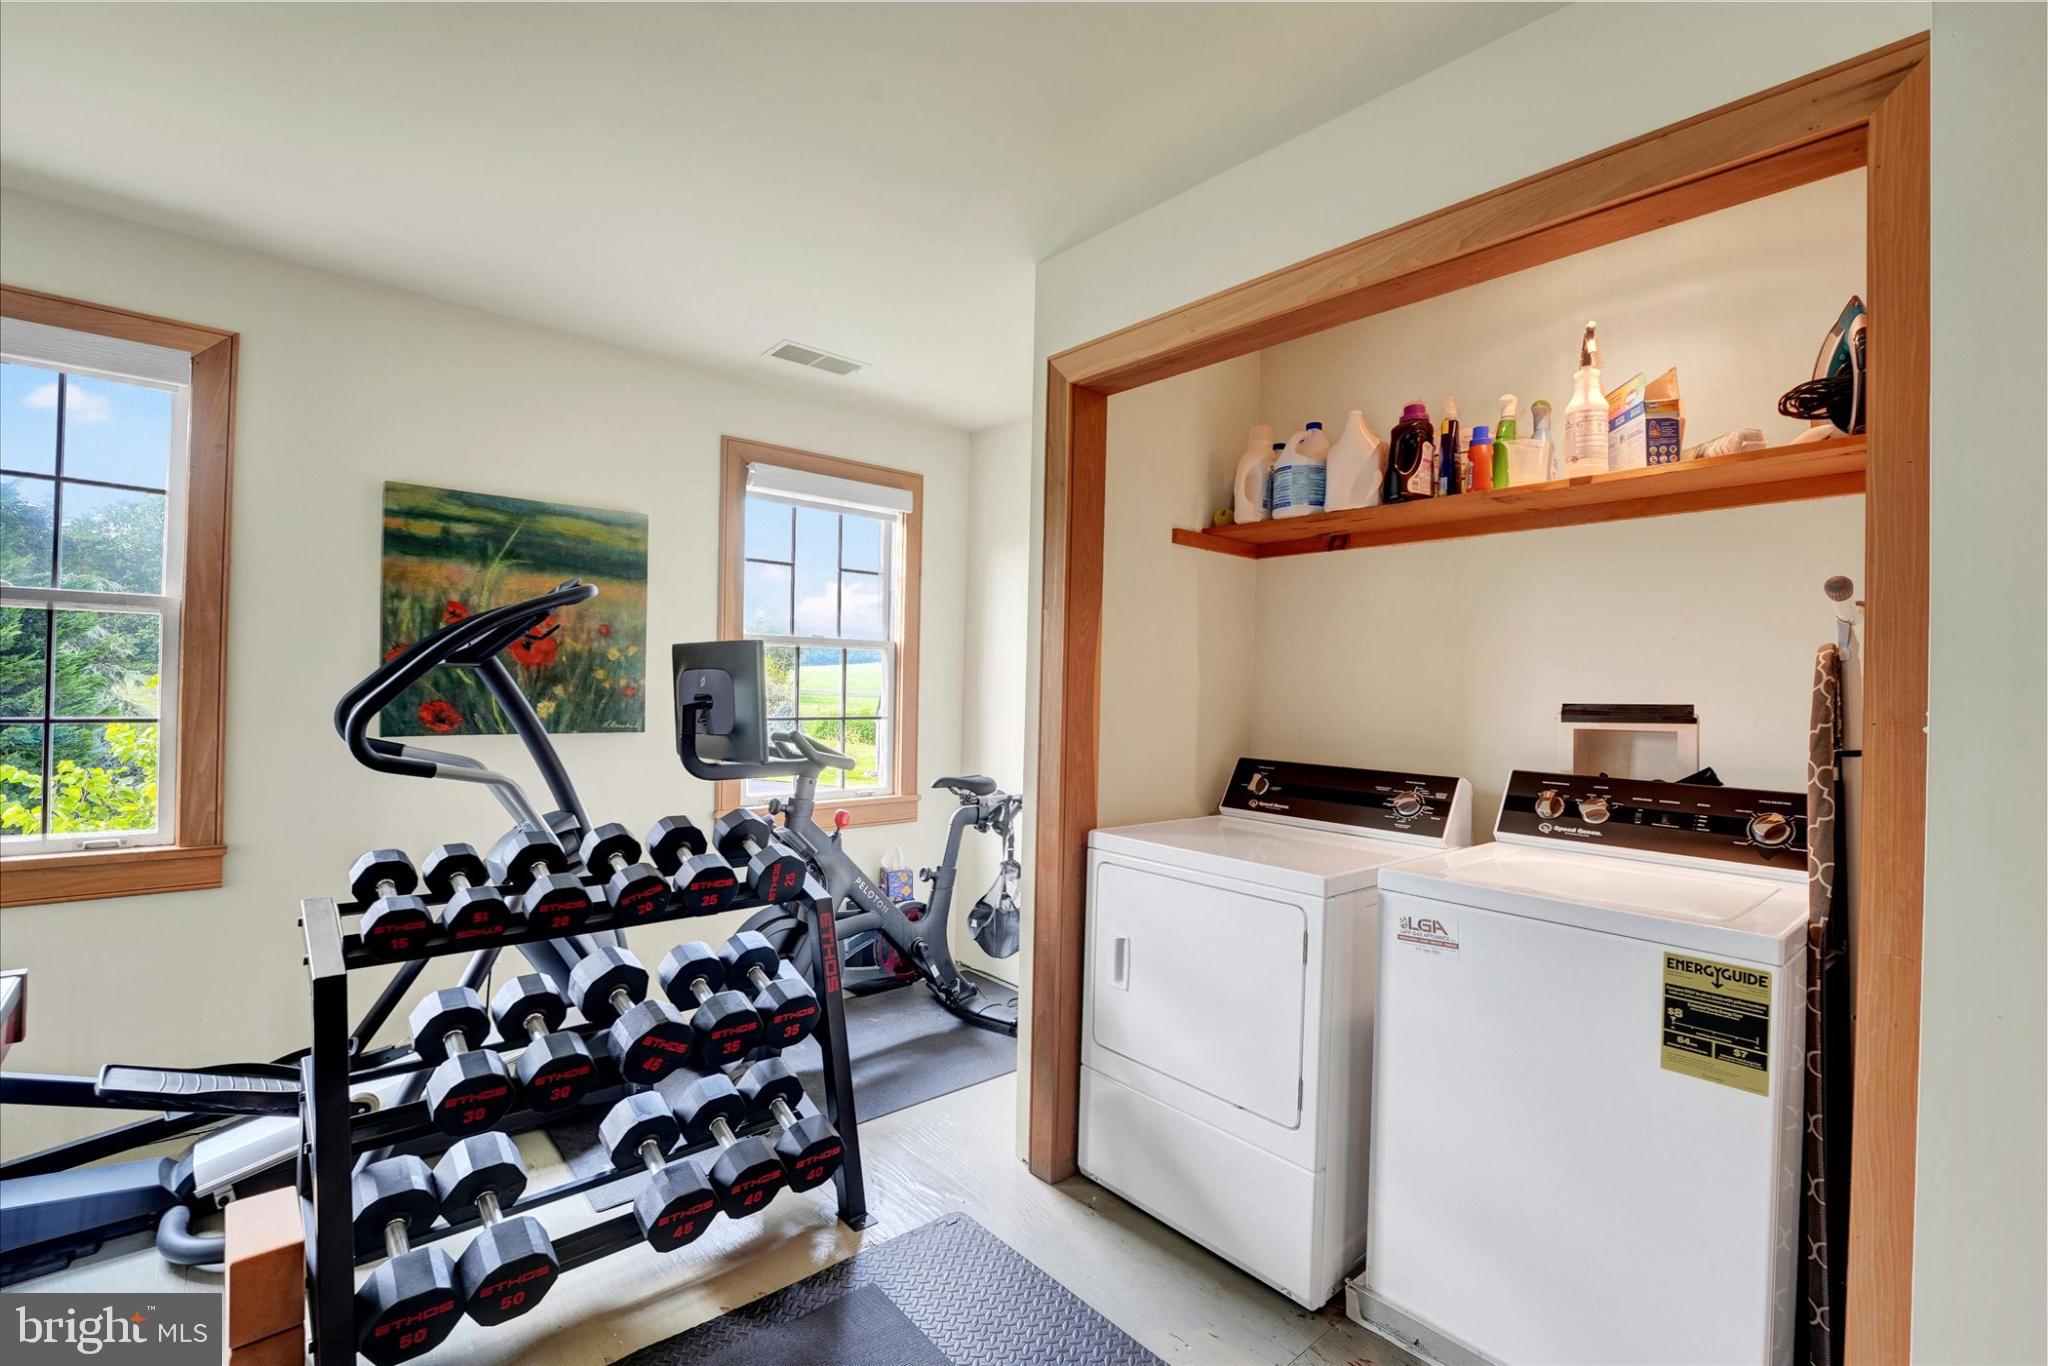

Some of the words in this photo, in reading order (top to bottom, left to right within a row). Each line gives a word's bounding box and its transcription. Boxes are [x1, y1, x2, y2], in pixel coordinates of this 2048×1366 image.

[1553, 824, 1576, 834] Speed
[690, 878, 734, 891] ETHOS
[768, 863, 782, 901] ETHOS
[784, 872, 796, 887] 25
[621, 884, 664, 906] ETHOS
[701, 894, 718, 906] 25
[855, 877, 889, 913] PELOTON
[637, 902, 653, 915] 20
[552, 916, 570, 928] 20
[1408, 916, 1449, 936] LGA
[391, 938, 408, 950] 15
[820, 912, 839, 993] ETHOS
[1666, 957, 1769, 988] ENERGYGUIDE
[774, 1006, 816, 1024] ETHOS
[1667, 1007, 1684, 1018] $8
[711, 1021, 758, 1040] ETHOS
[783, 1023, 800, 1038] 35
[642, 1036, 688, 1054] ETHOS
[722, 1040, 741, 1055] 35
[642, 1056, 664, 1071] 45
[534, 1065, 591, 1087] ETHOS
[550, 1086, 571, 1100] 30
[463, 1107, 485, 1124] 30
[796, 1146, 841, 1169] ETHOS
[730, 1169, 782, 1195] ETHOS
[805, 1166, 825, 1180] 40
[744, 1190, 763, 1206] 40
[658, 1199, 714, 1227] ETHOS
[673, 1221, 694, 1239] 45
[480, 1265, 550, 1299] ETHOS
[500, 1290, 525, 1311] 50
[375, 1300, 455, 1338] ETHOS
[399, 1327, 428, 1349] 50
